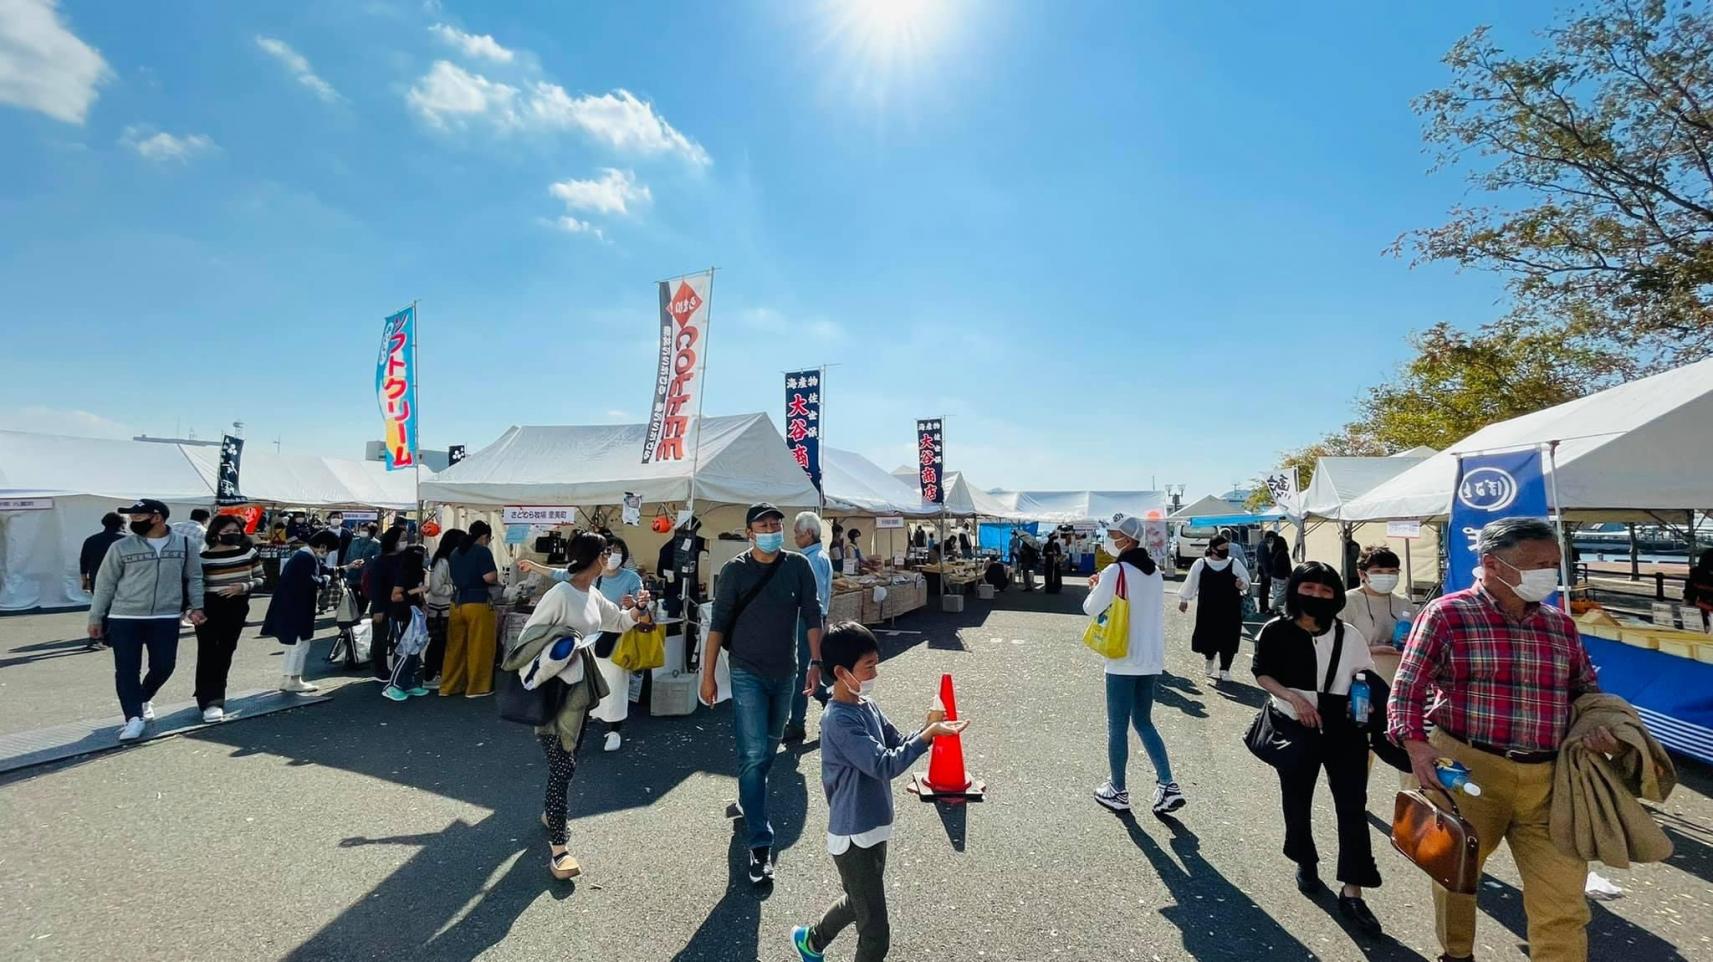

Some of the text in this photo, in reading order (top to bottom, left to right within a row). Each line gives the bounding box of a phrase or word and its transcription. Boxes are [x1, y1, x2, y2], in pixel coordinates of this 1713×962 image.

[384, 312, 412, 466] ソフトクリーム
[787, 376, 818, 389] 海産物
[788, 393, 812, 478] 大谷商
[920, 433, 938, 501] 大谷商店
